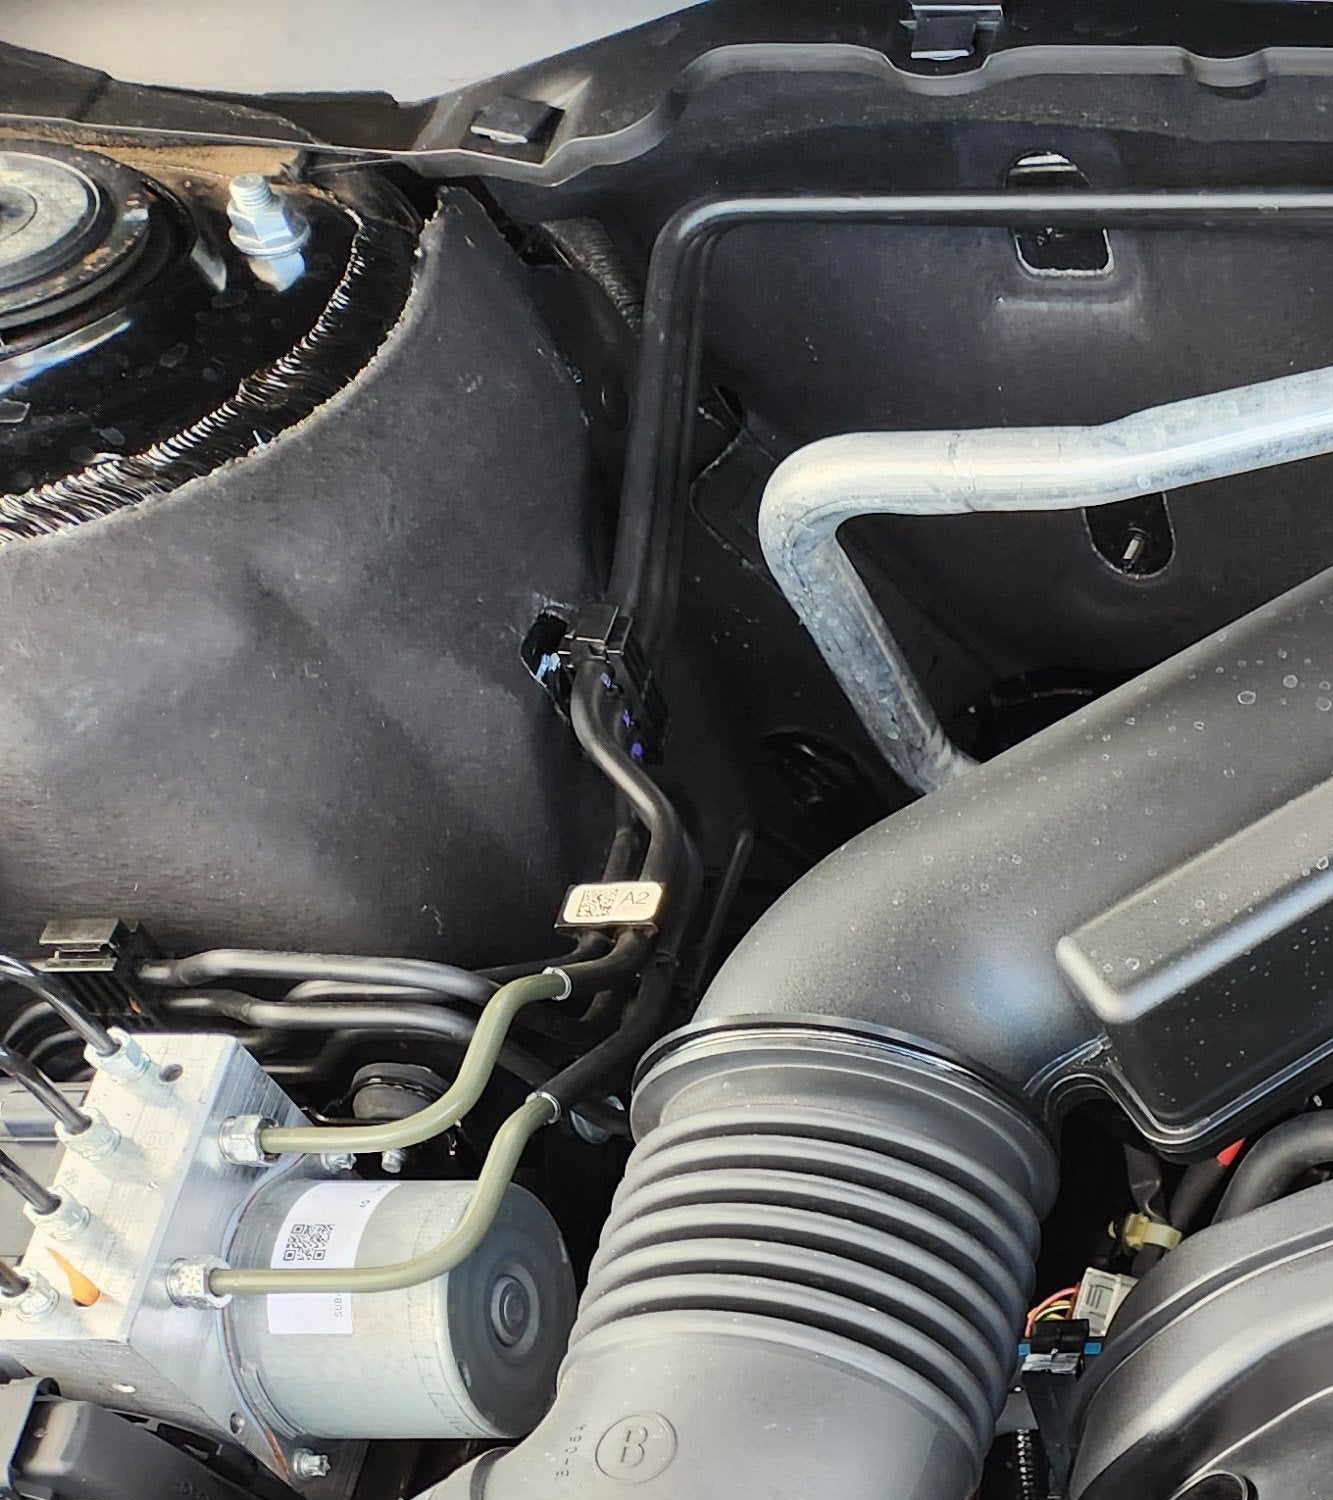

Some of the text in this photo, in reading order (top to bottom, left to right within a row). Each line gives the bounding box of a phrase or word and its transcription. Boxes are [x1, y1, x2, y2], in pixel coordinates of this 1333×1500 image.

[620, 891, 650, 905] A2
[333, 1293, 343, 1318] SUB
[620, 1427, 648, 1468] B
